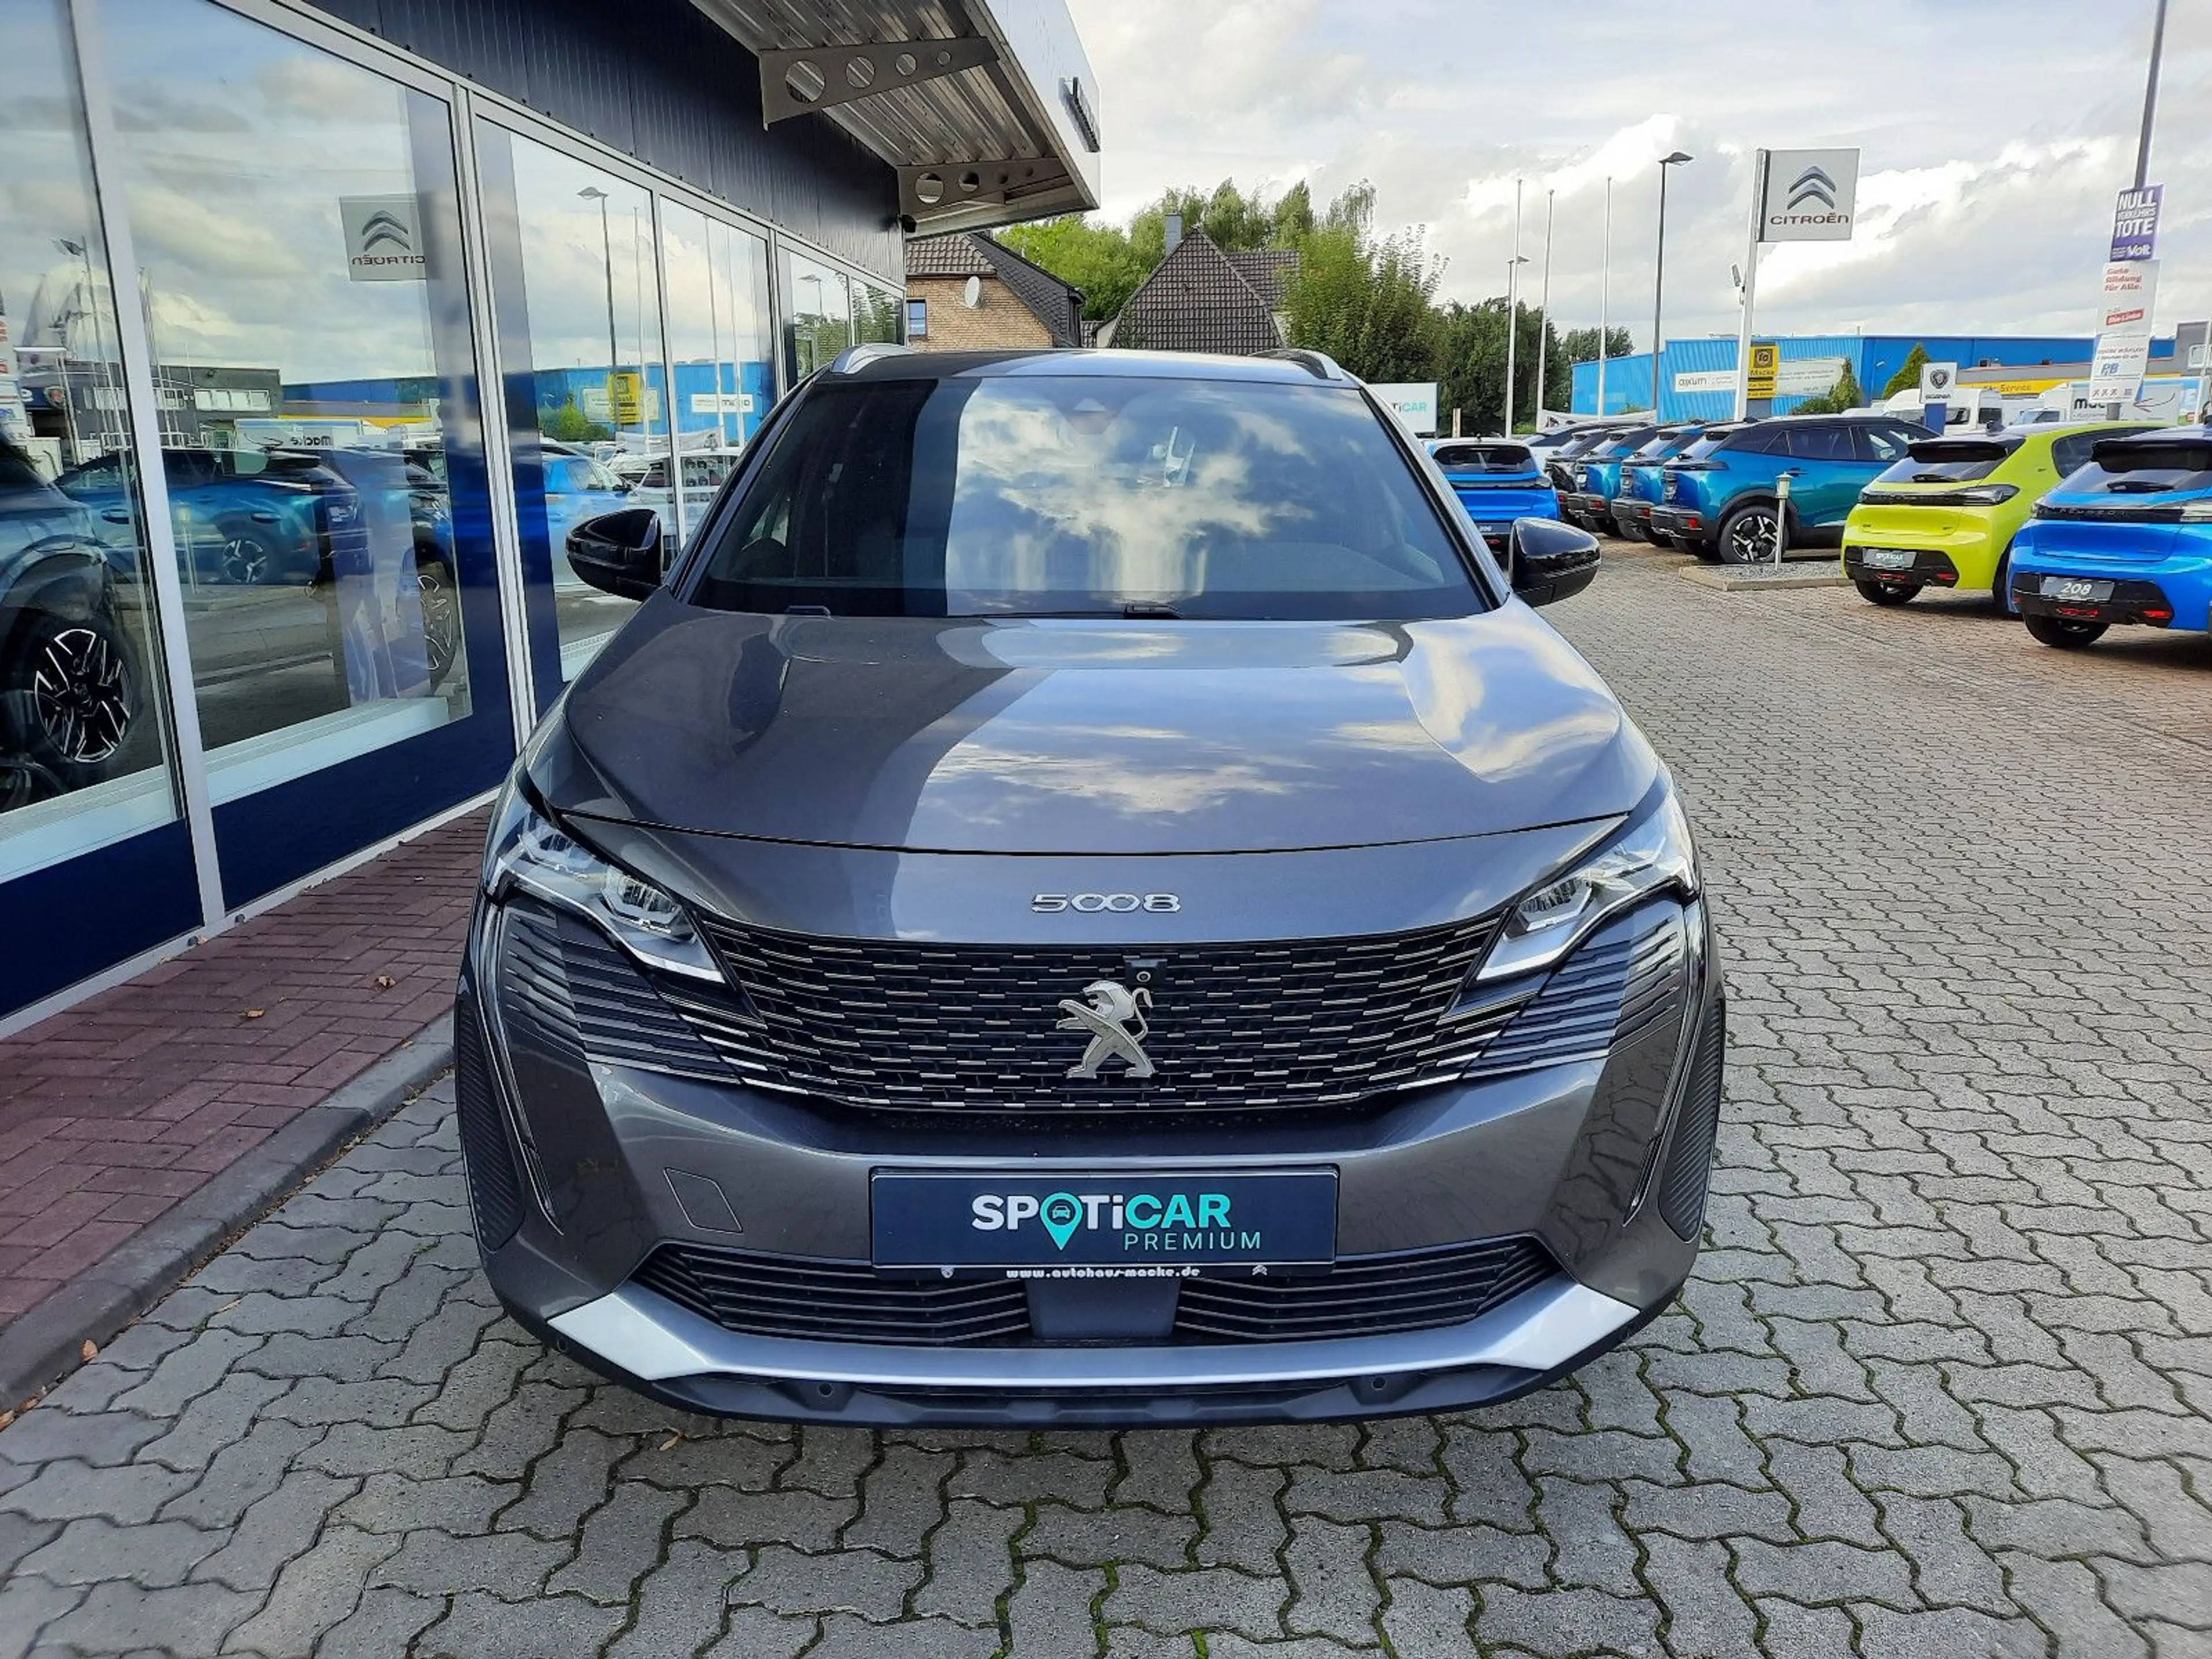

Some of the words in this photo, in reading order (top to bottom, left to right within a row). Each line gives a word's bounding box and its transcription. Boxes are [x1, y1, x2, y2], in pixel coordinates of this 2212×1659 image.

[2119, 190, 2158, 211] NULL
[2116, 217, 2156, 238] TOTE
[2061, 582, 2093, 595] 208
[1031, 893, 1181, 912] 5008
[1124, 1232, 1262, 1251] PREMIUM
[1006, 1267, 1200, 1278] www.autohaus-macke.de
